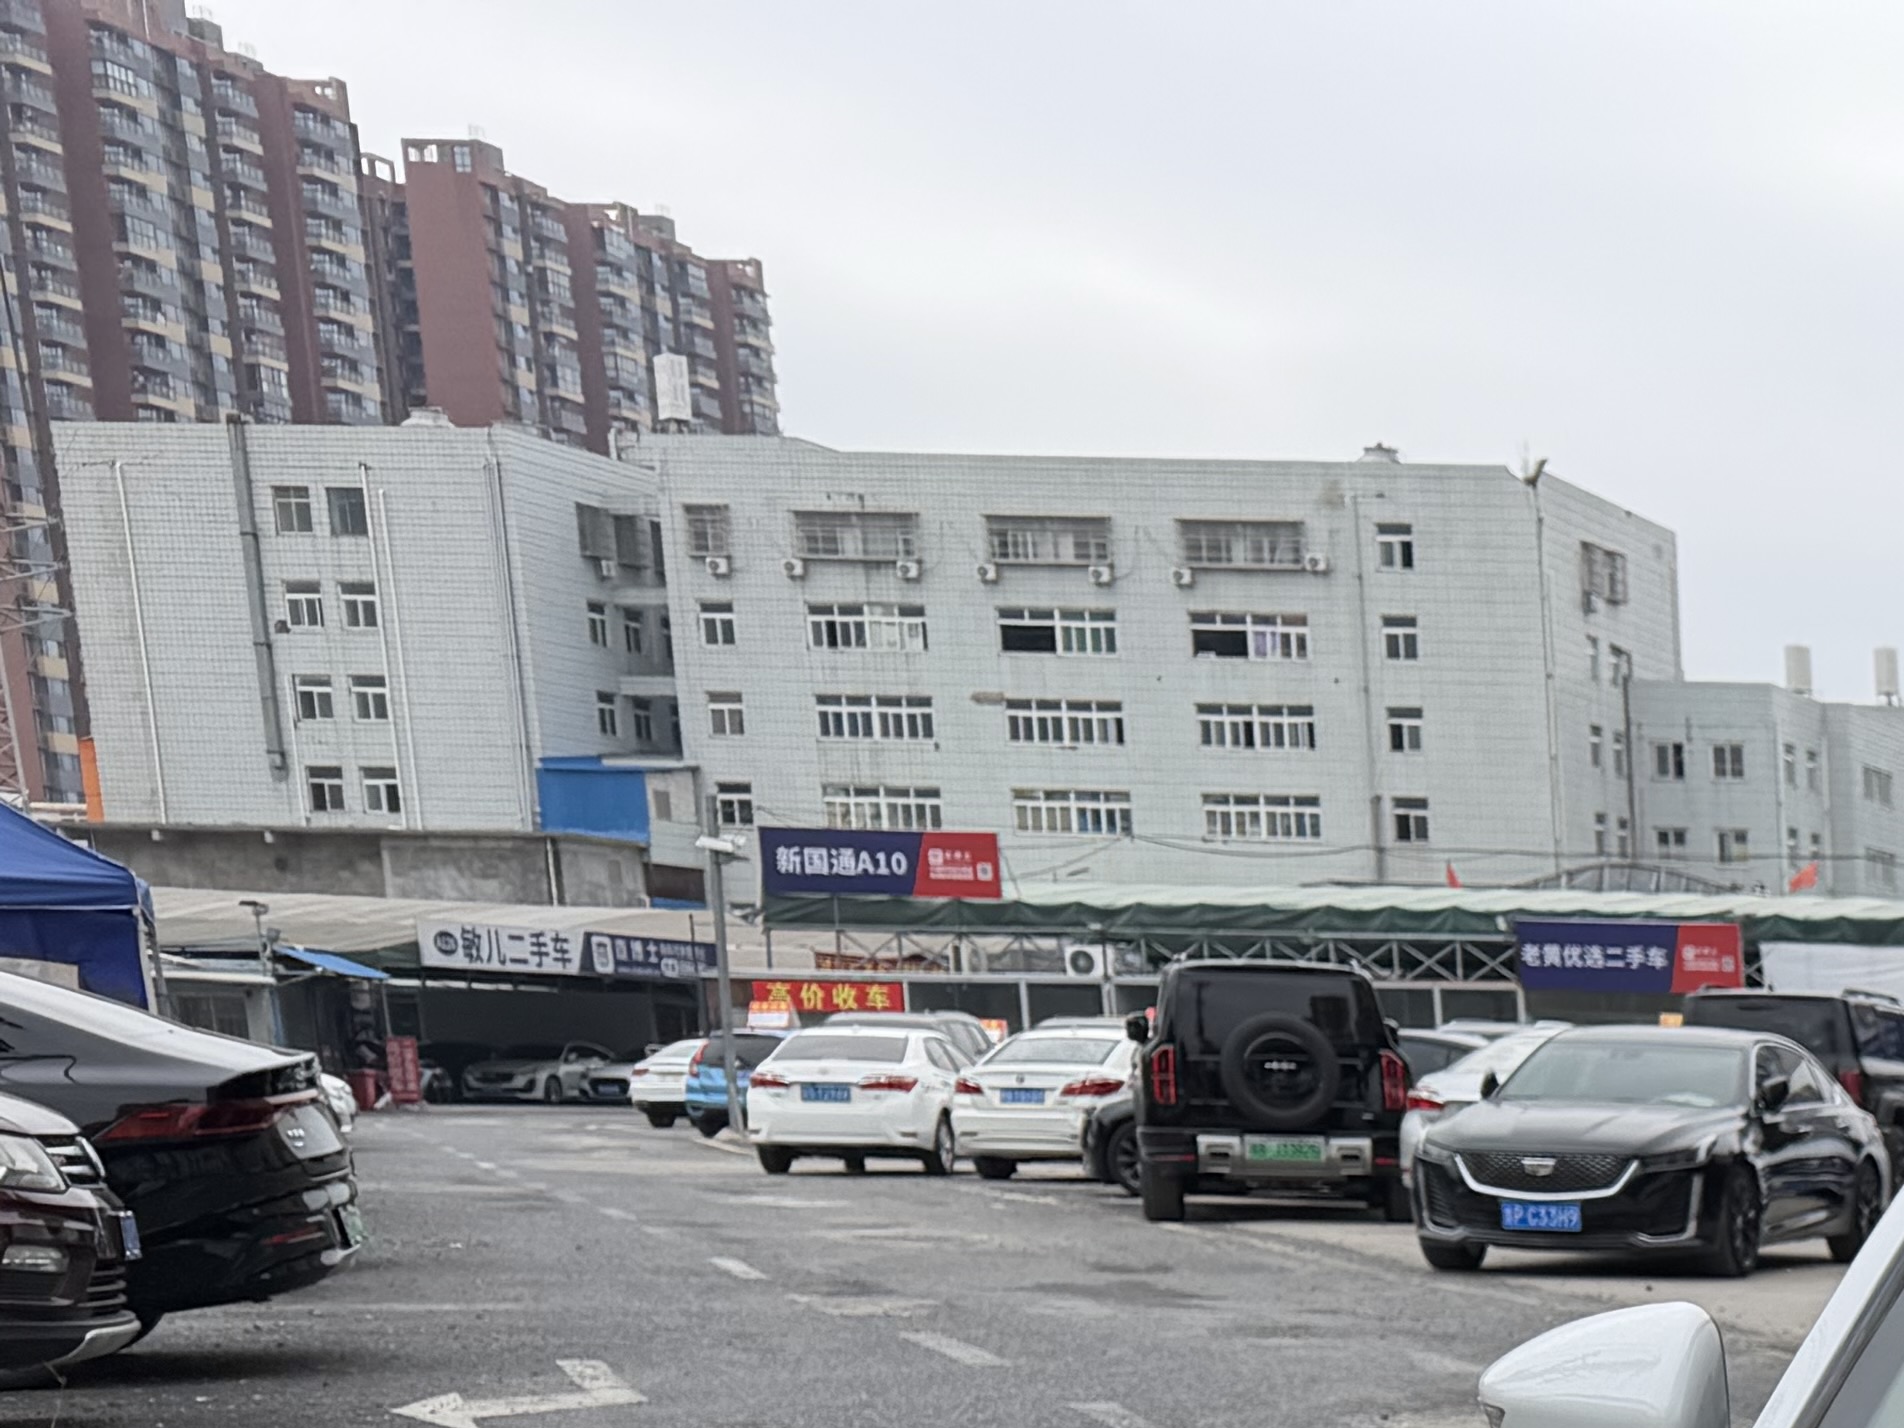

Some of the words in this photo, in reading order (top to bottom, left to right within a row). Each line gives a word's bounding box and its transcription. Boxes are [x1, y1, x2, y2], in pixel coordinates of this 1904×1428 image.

[775, 846, 908, 876] 新国通A10
[460, 925, 573, 969] 敏儿二手车
[765, 982, 892, 1010] 高价收车
